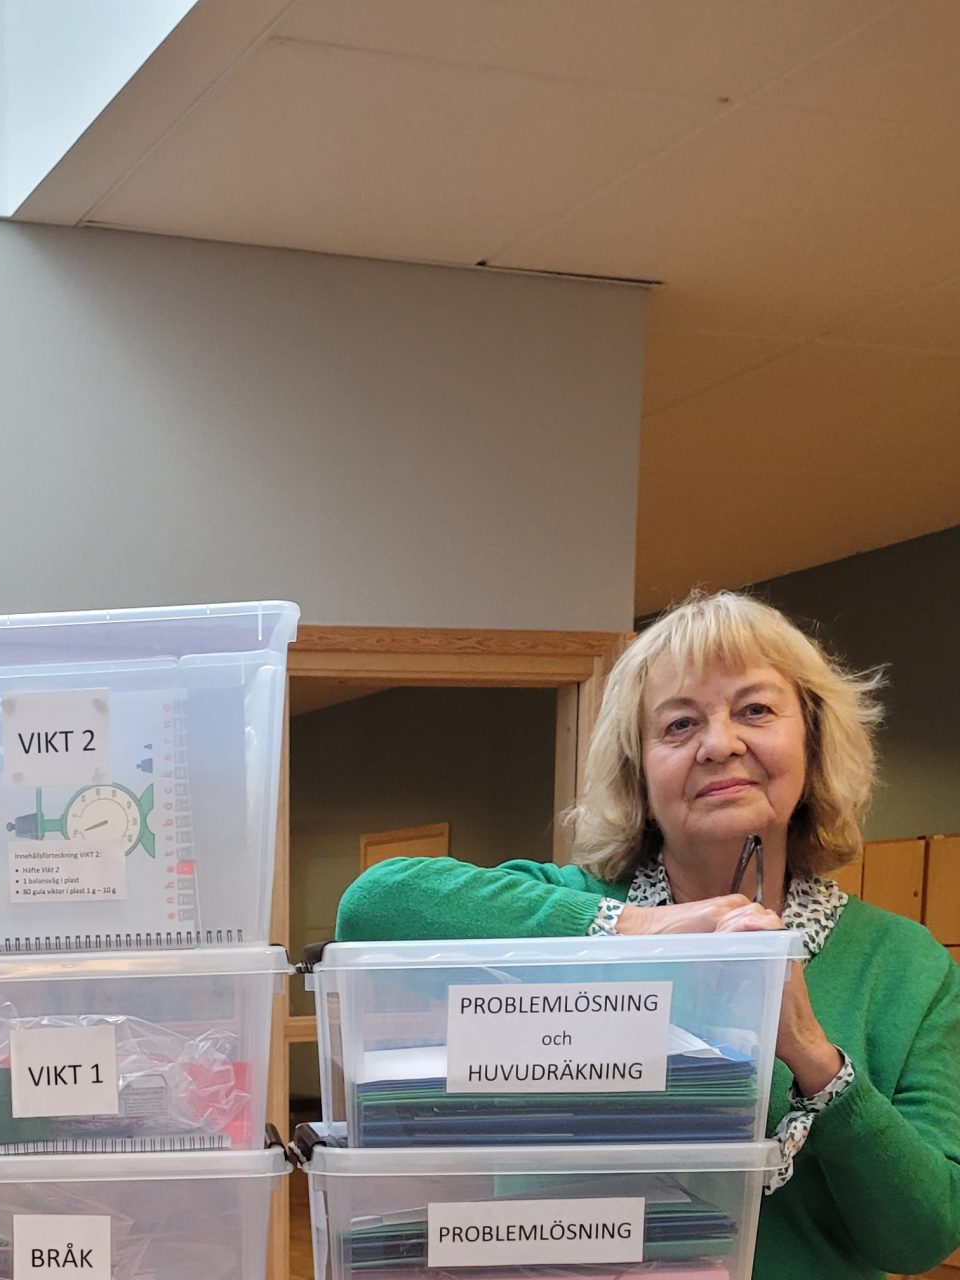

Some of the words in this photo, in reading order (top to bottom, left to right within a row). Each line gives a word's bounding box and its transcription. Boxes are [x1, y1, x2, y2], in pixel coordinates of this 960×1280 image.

[17, 730, 75, 755] VIKT
[82, 729, 96, 752] 2
[460, 991, 659, 1015] PROBLEMLÖSNING
[541, 1029, 572, 1046] och
[27, 1064, 83, 1087] VIKT
[90, 1063, 104, 1084] 1
[468, 1059, 643, 1082] HUVUDRÄKNING
[439, 1219, 632, 1243] PROBLEMLÖSNING
[31, 1242, 94, 1269] BRÅK
